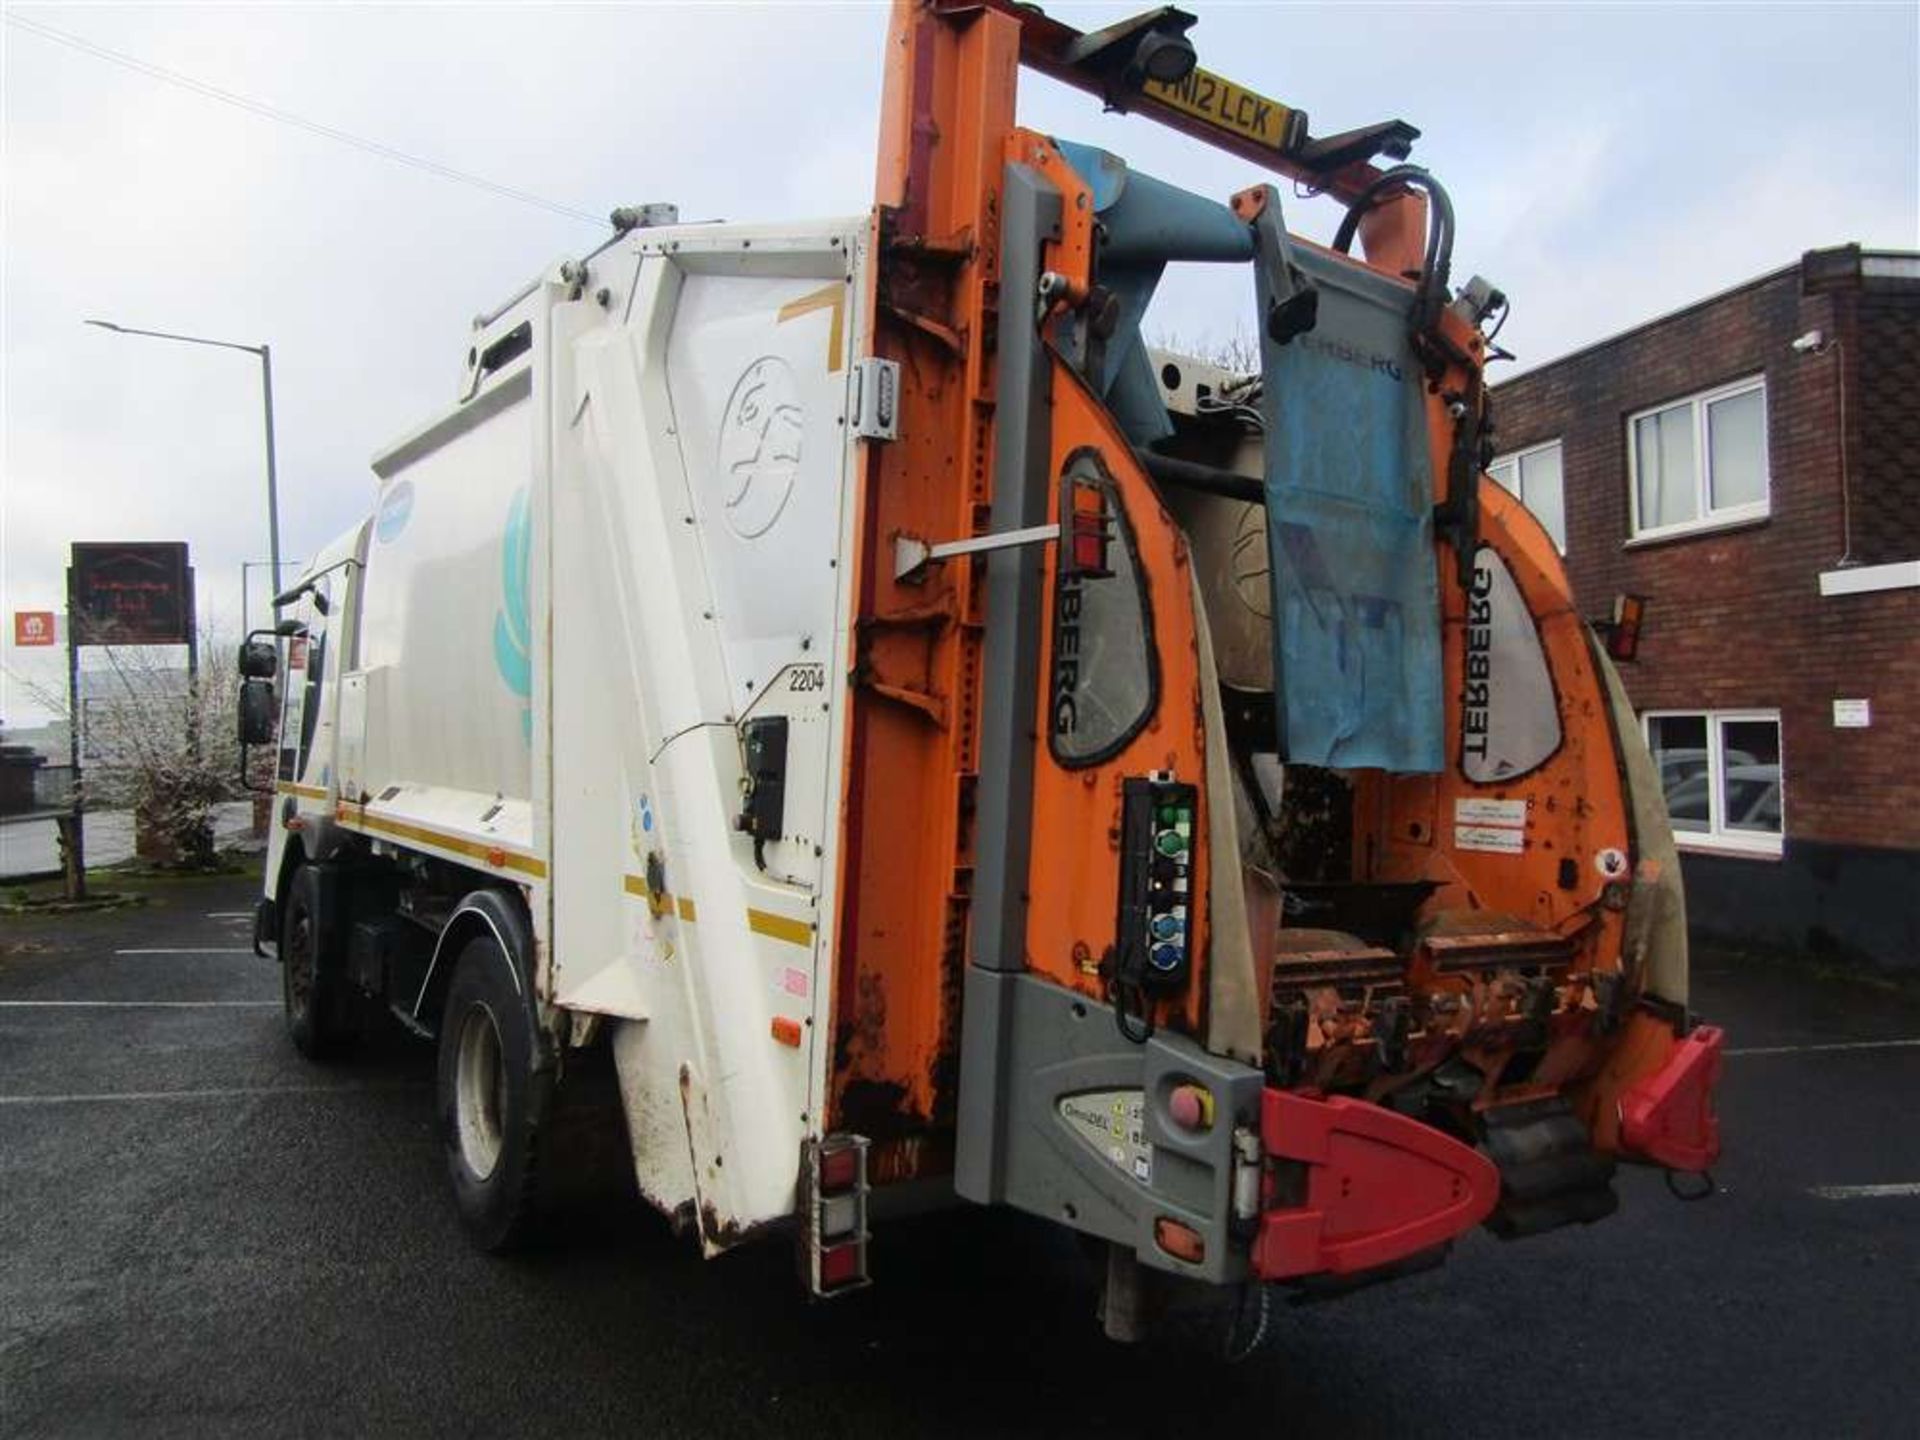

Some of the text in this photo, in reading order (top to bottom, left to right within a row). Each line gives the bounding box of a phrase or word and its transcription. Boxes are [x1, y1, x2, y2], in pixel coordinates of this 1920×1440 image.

[1161, 73, 1272, 135] N12 LCK
[790, 669, 824, 691] 2204
[1464, 567, 1492, 761] TERBERG
